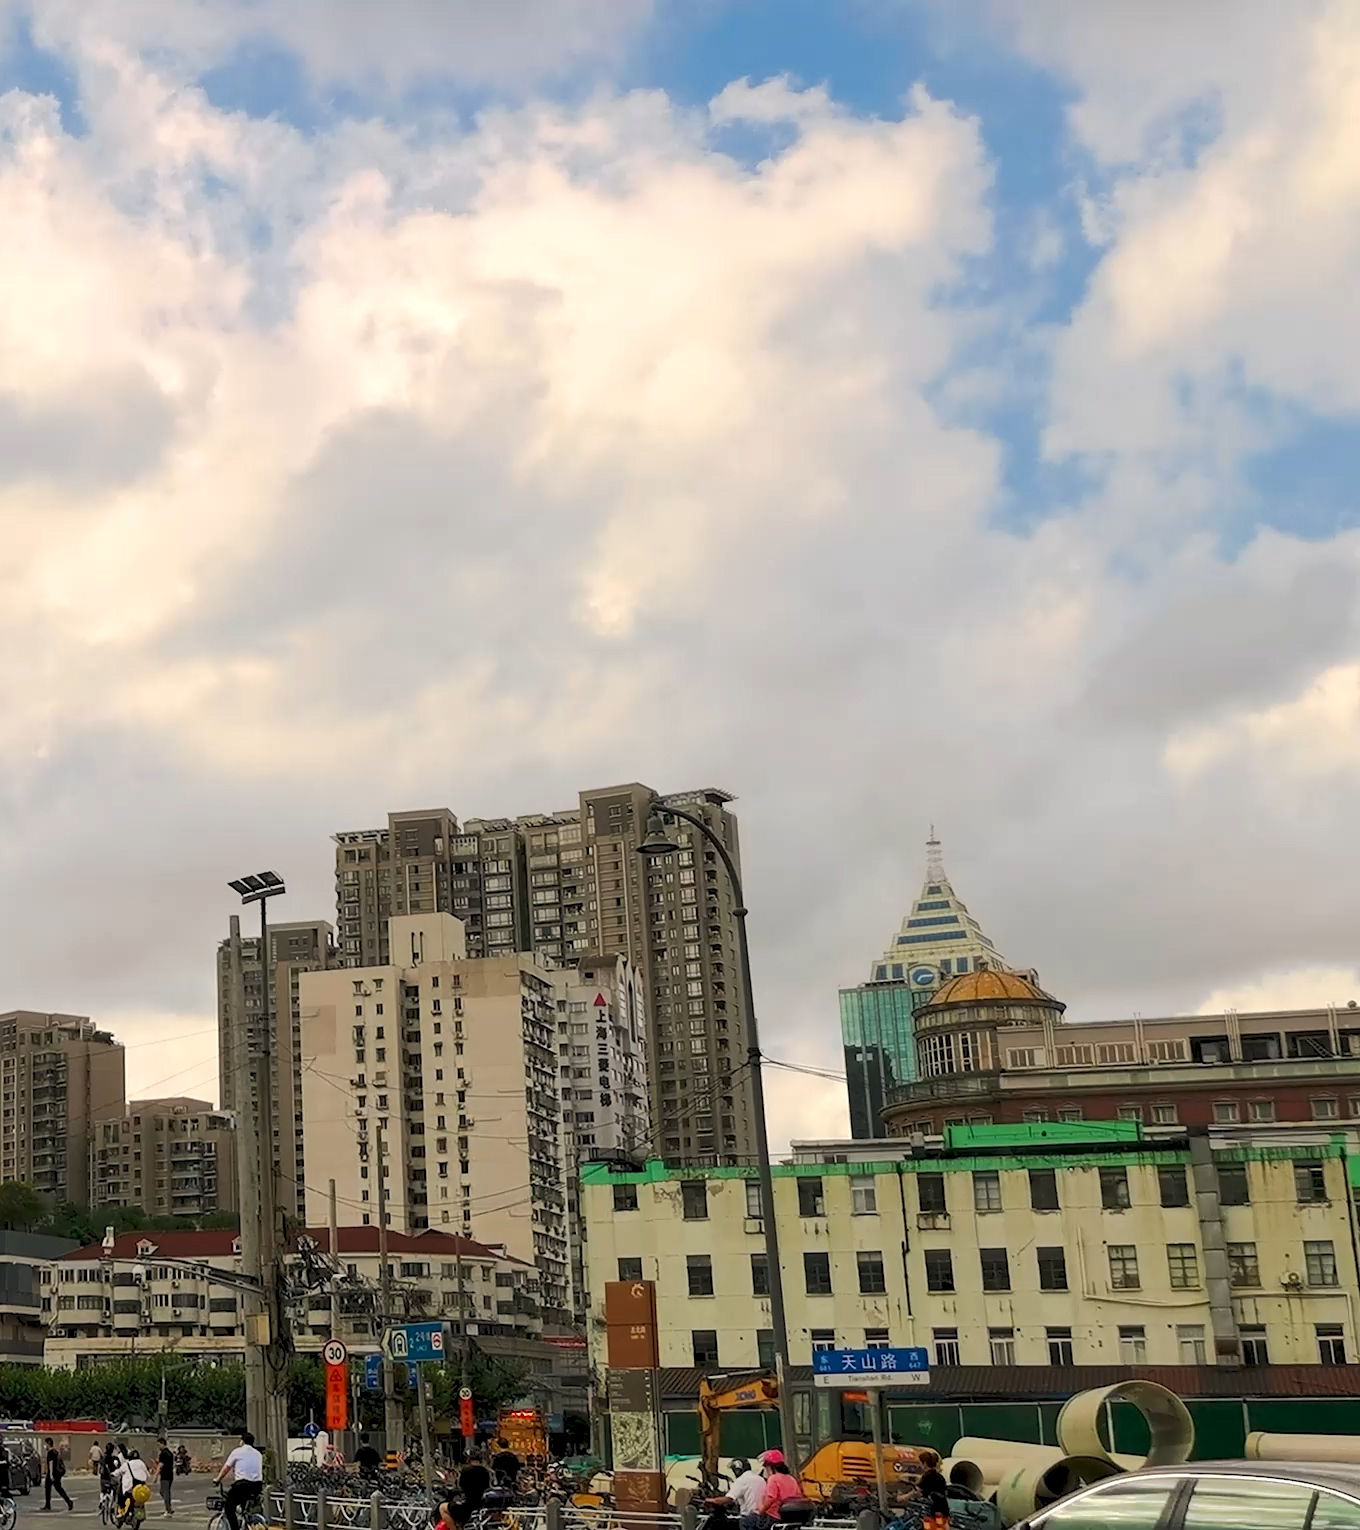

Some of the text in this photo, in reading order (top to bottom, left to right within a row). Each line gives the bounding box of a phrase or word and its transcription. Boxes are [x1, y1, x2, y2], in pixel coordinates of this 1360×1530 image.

[595, 1009, 612, 1107] 上海三菱电梯
[328, 1347, 341, 1360] 30
[841, 1352, 897, 1371] 天山路
[909, 1351, 919, 1361] 西
[823, 1375, 830, 1385] E
[911, 1373, 921, 1382] W
